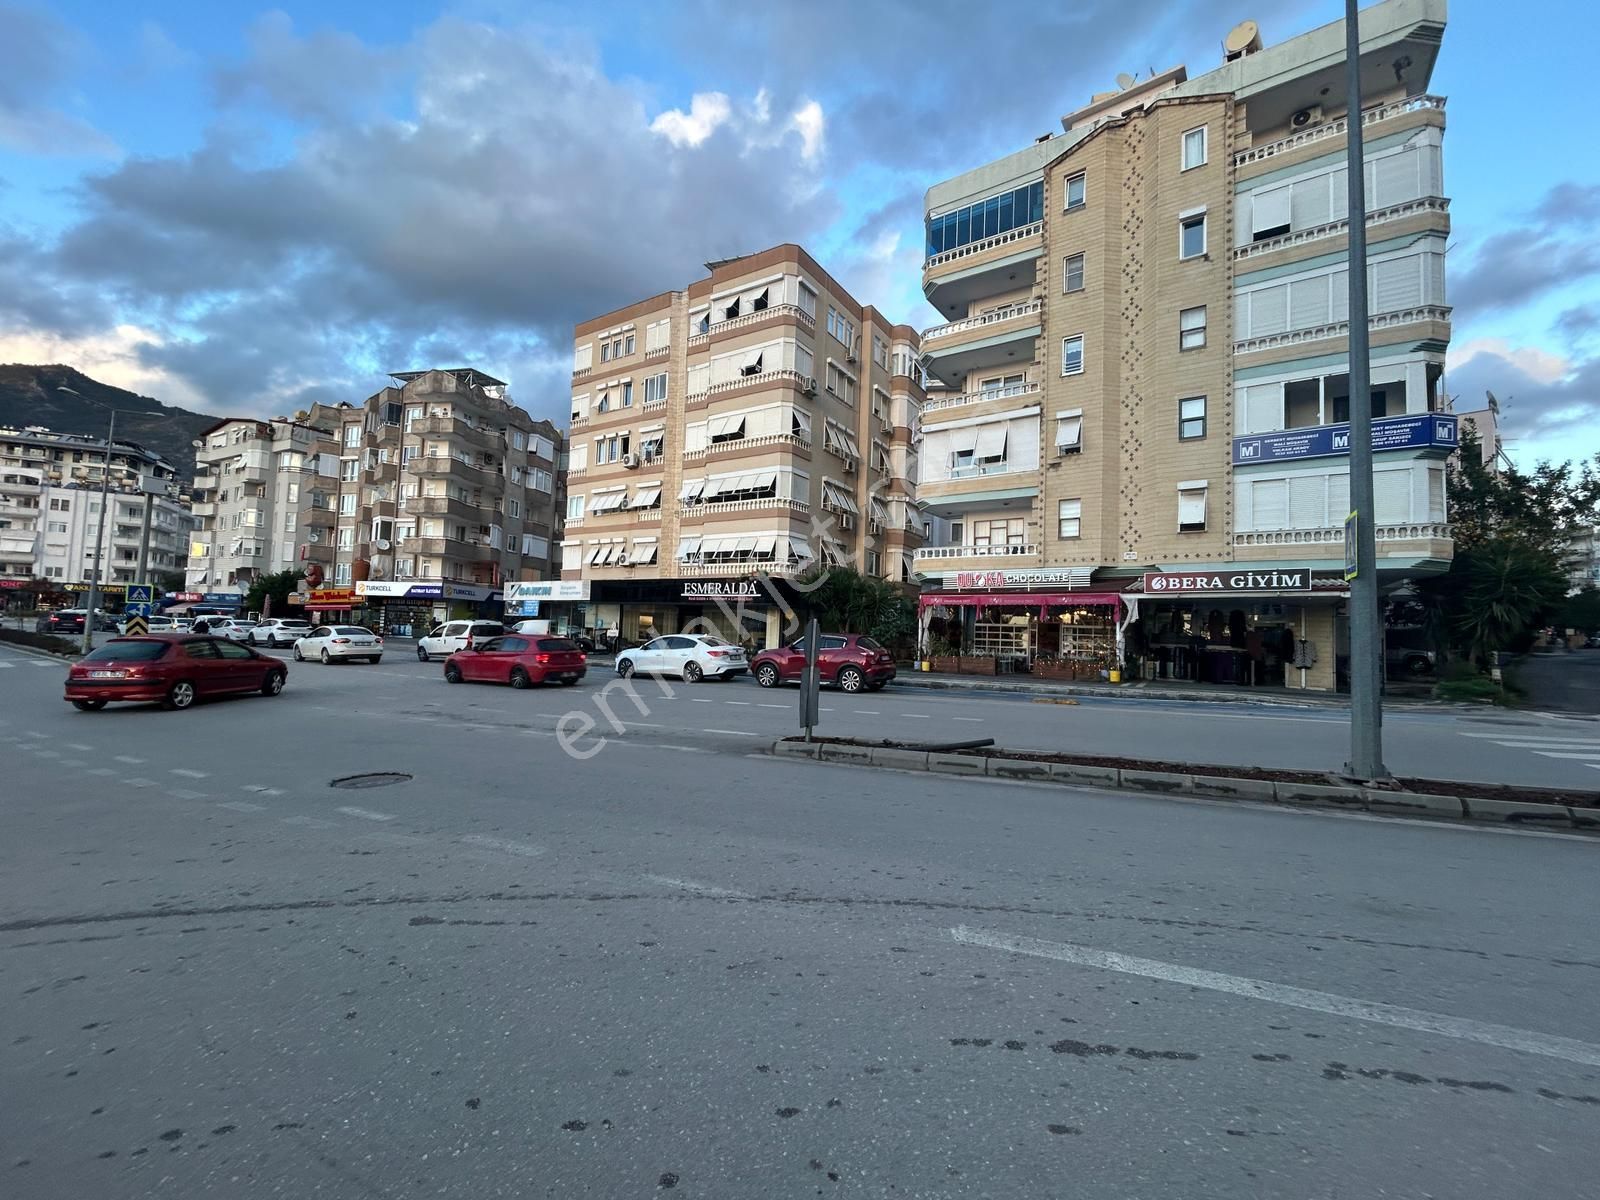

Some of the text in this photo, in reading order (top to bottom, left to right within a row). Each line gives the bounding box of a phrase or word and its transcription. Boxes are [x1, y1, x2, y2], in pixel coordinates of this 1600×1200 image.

[1006, 573, 1069, 584] CHOCOLATE
[1168, 572, 1302, 589] BERA GİYİM
[453, 588, 476, 597] TURKCELL
[684, 582, 757, 595] ESMERALDA
